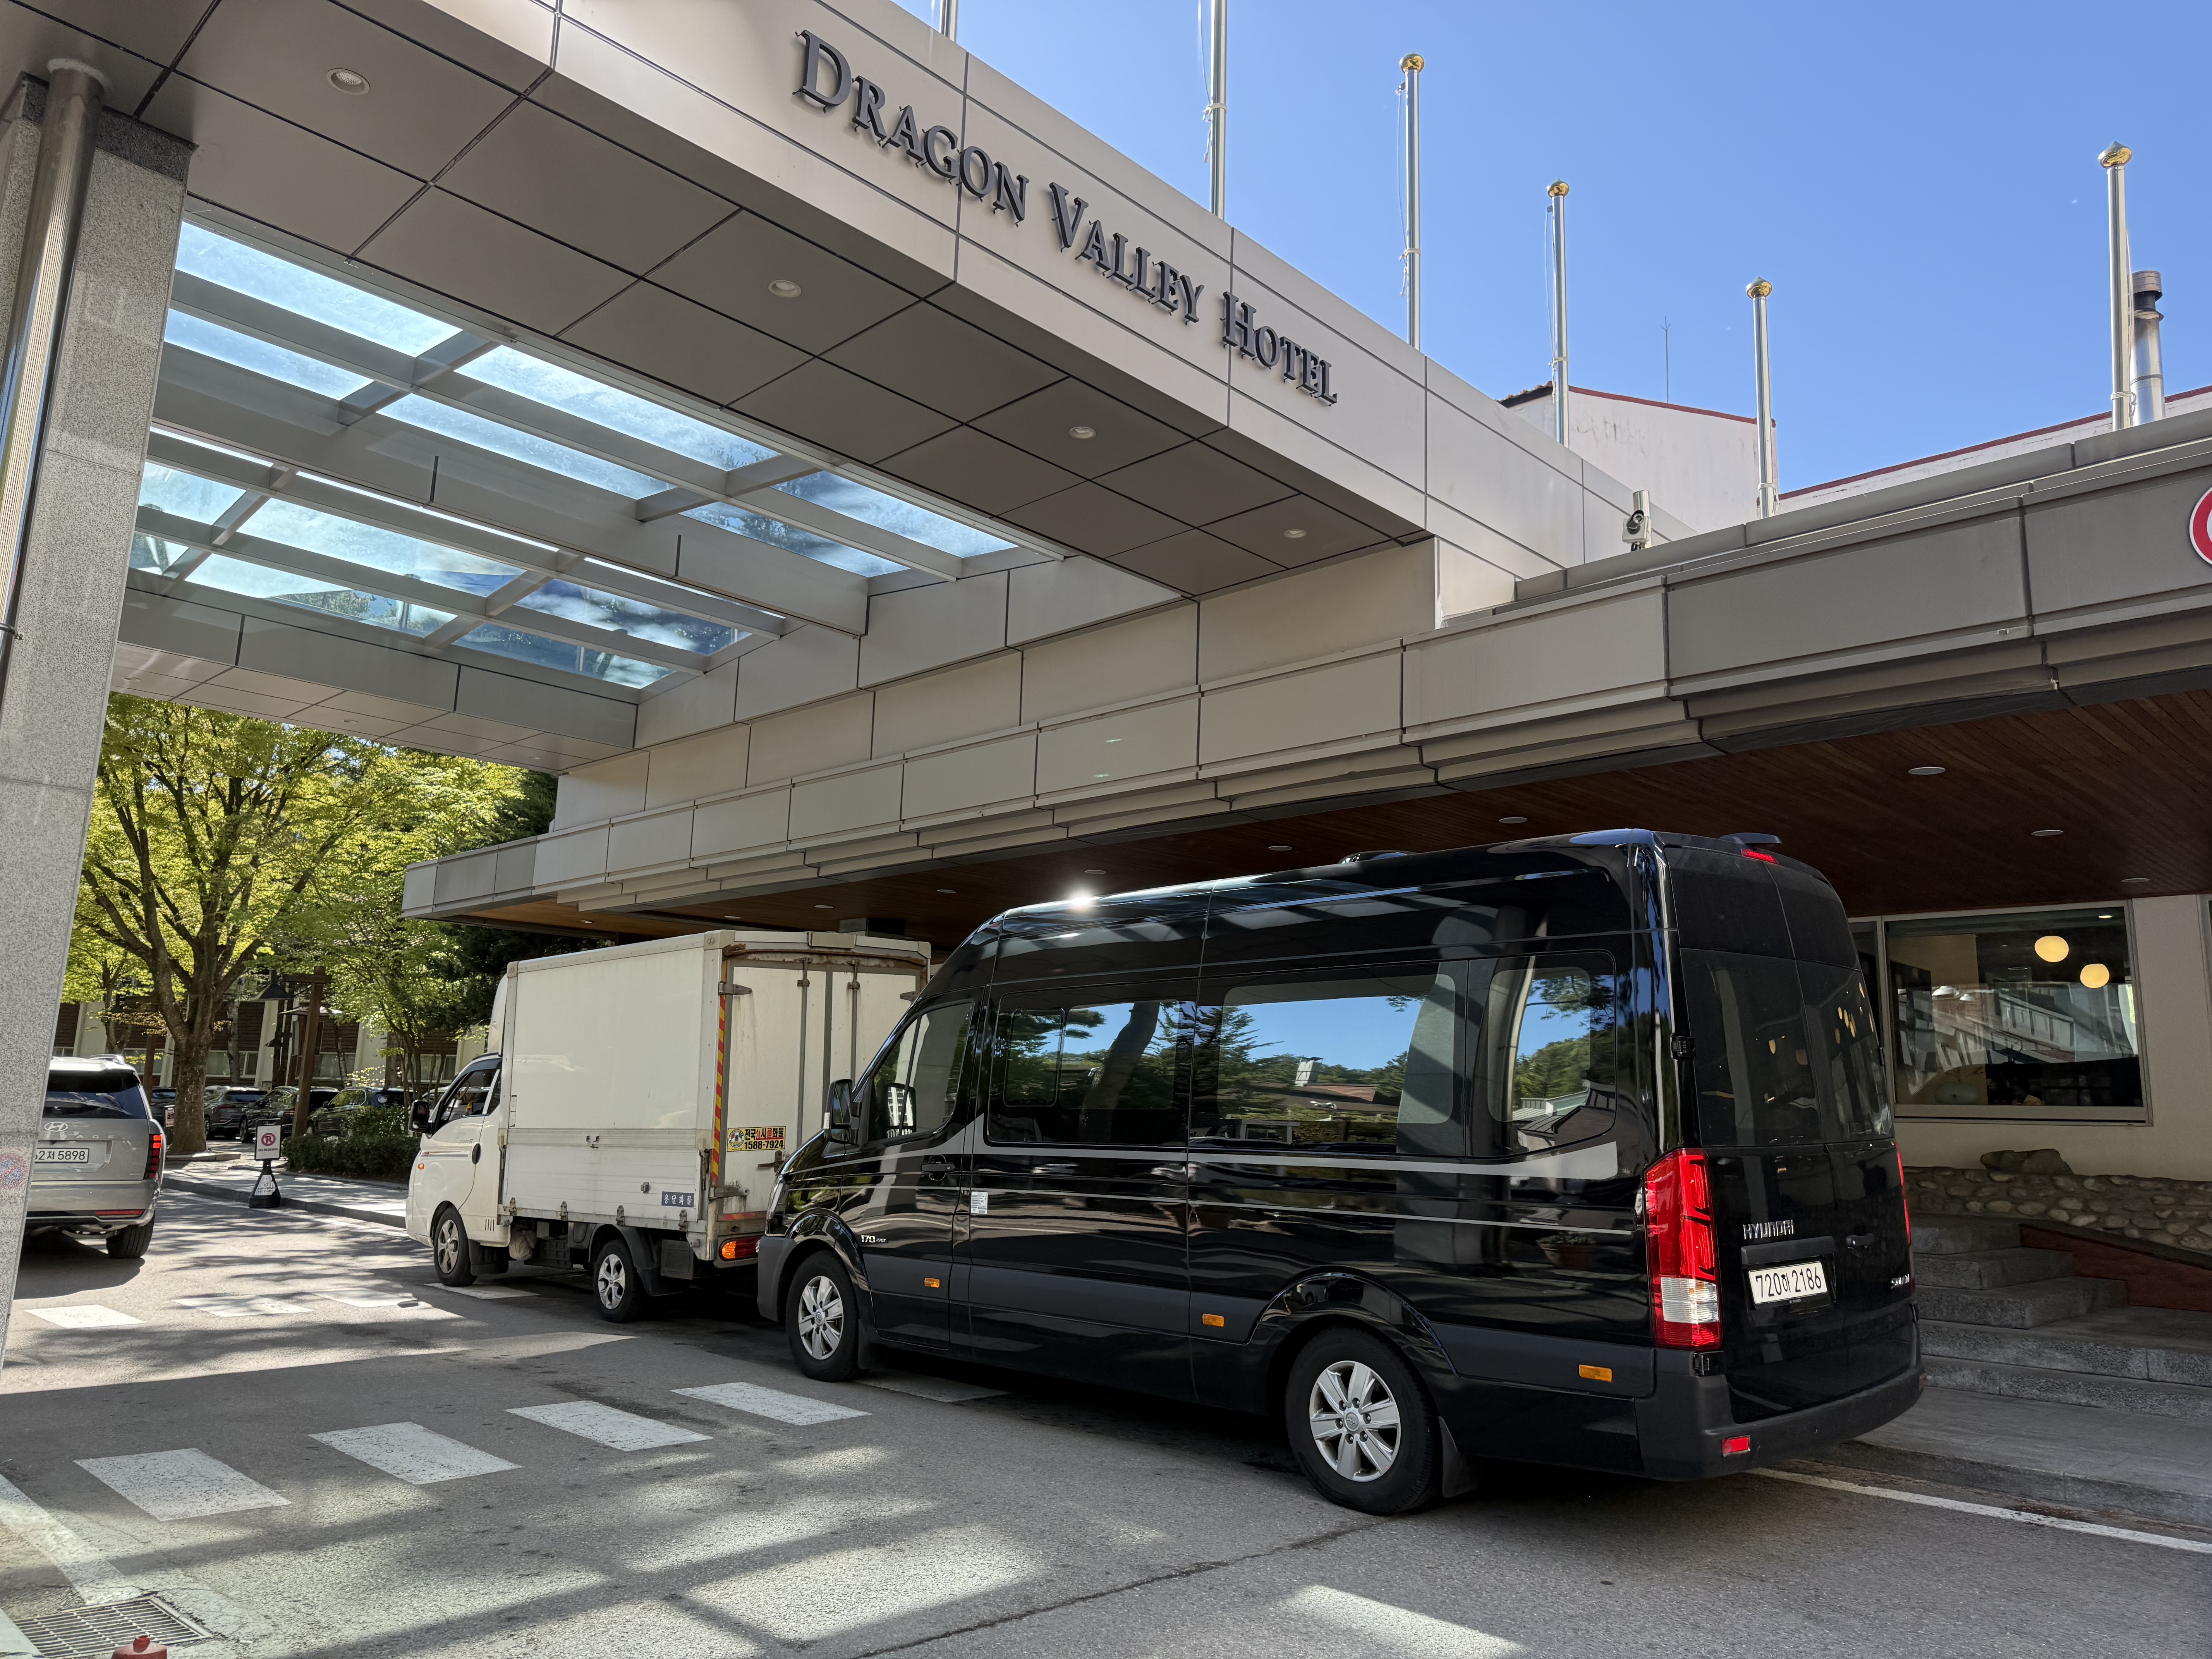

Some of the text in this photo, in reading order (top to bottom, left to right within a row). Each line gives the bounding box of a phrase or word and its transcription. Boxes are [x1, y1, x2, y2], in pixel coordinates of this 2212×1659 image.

[799, 29, 1338, 405] DRAGON VALLEY HOTEL
[744, 1140, 783, 1149] 1588-7924
[35, 1151, 55, 1160] 2저
[1743, 1219, 1794, 1240] HYUNDAI
